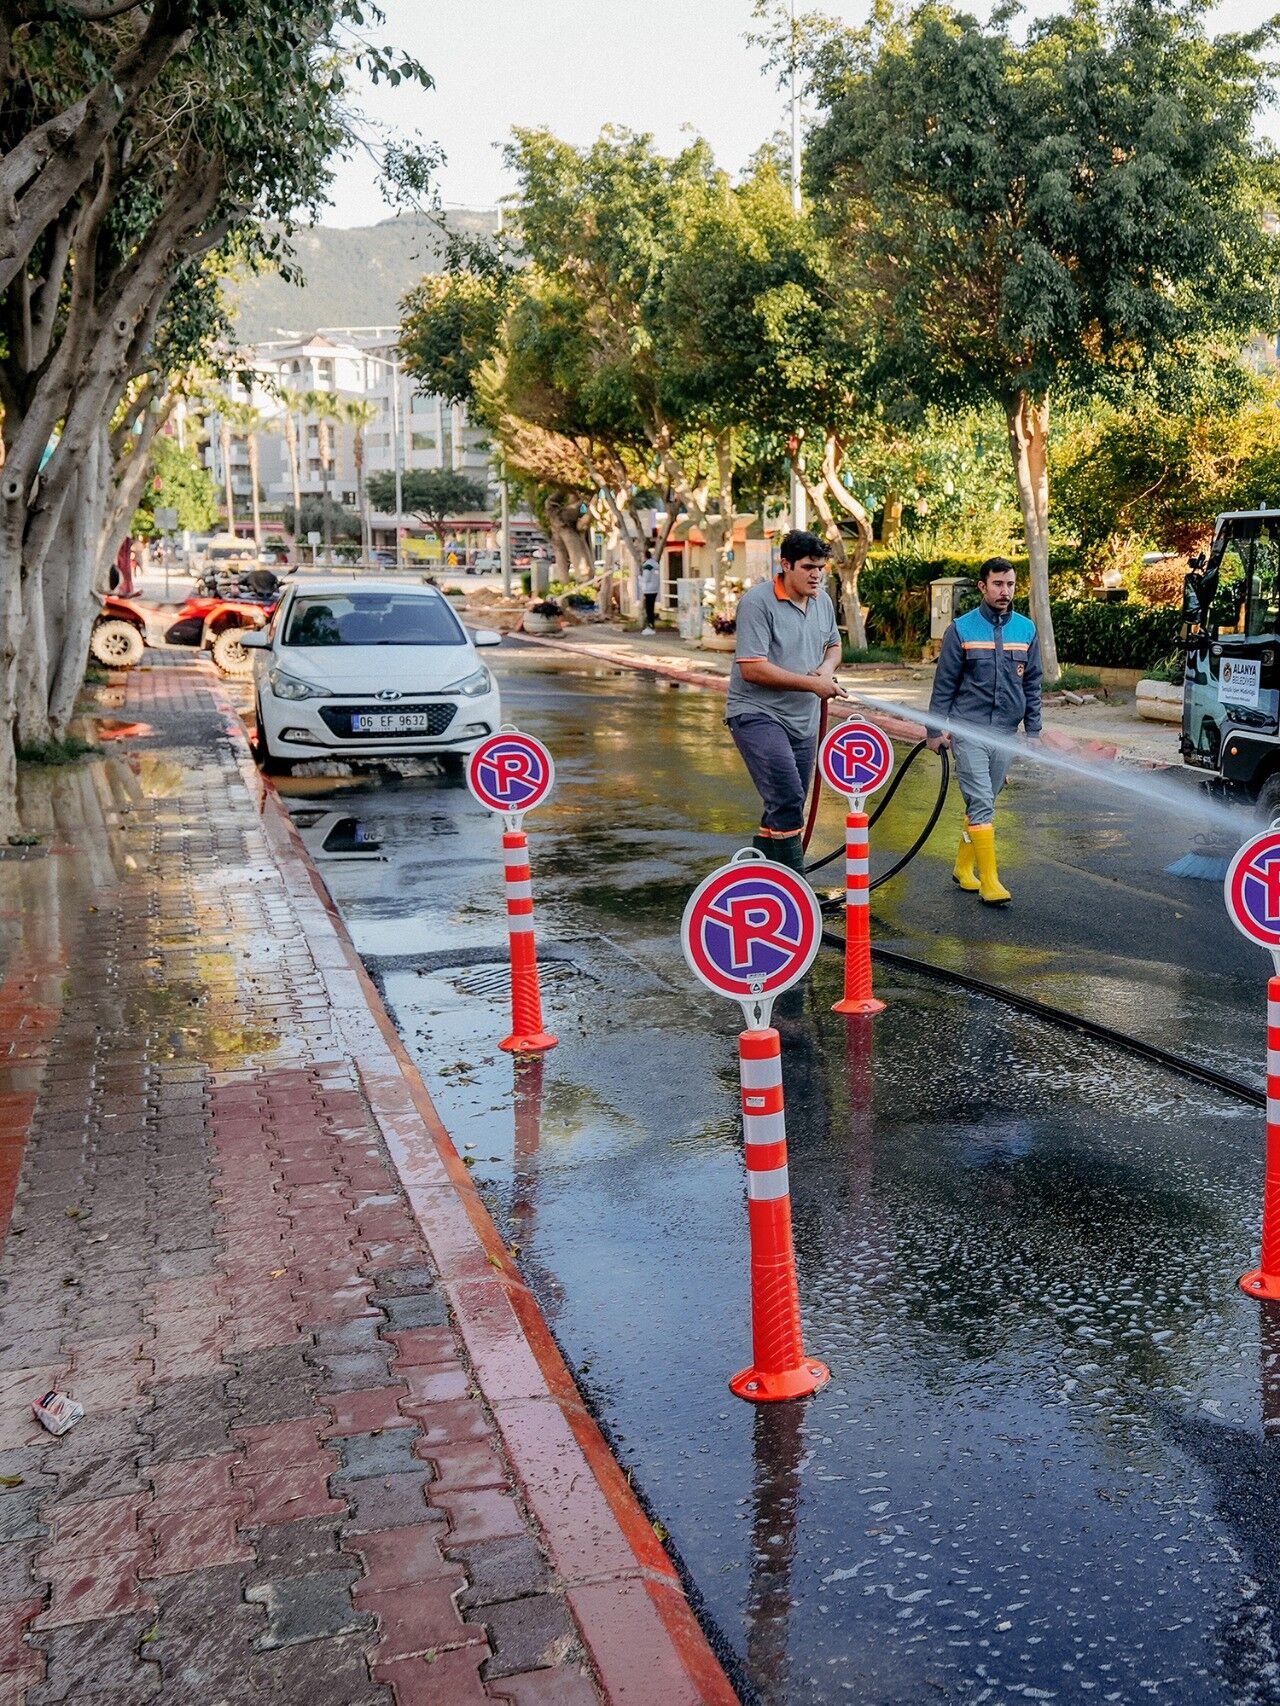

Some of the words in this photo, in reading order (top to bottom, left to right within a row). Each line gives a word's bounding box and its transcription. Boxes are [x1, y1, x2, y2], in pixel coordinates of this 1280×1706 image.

[1232, 663, 1257, 676] ALANYA
[360, 716, 373, 727] 06
[380, 716, 393, 727] EF
[399, 715, 425, 726] 9632
